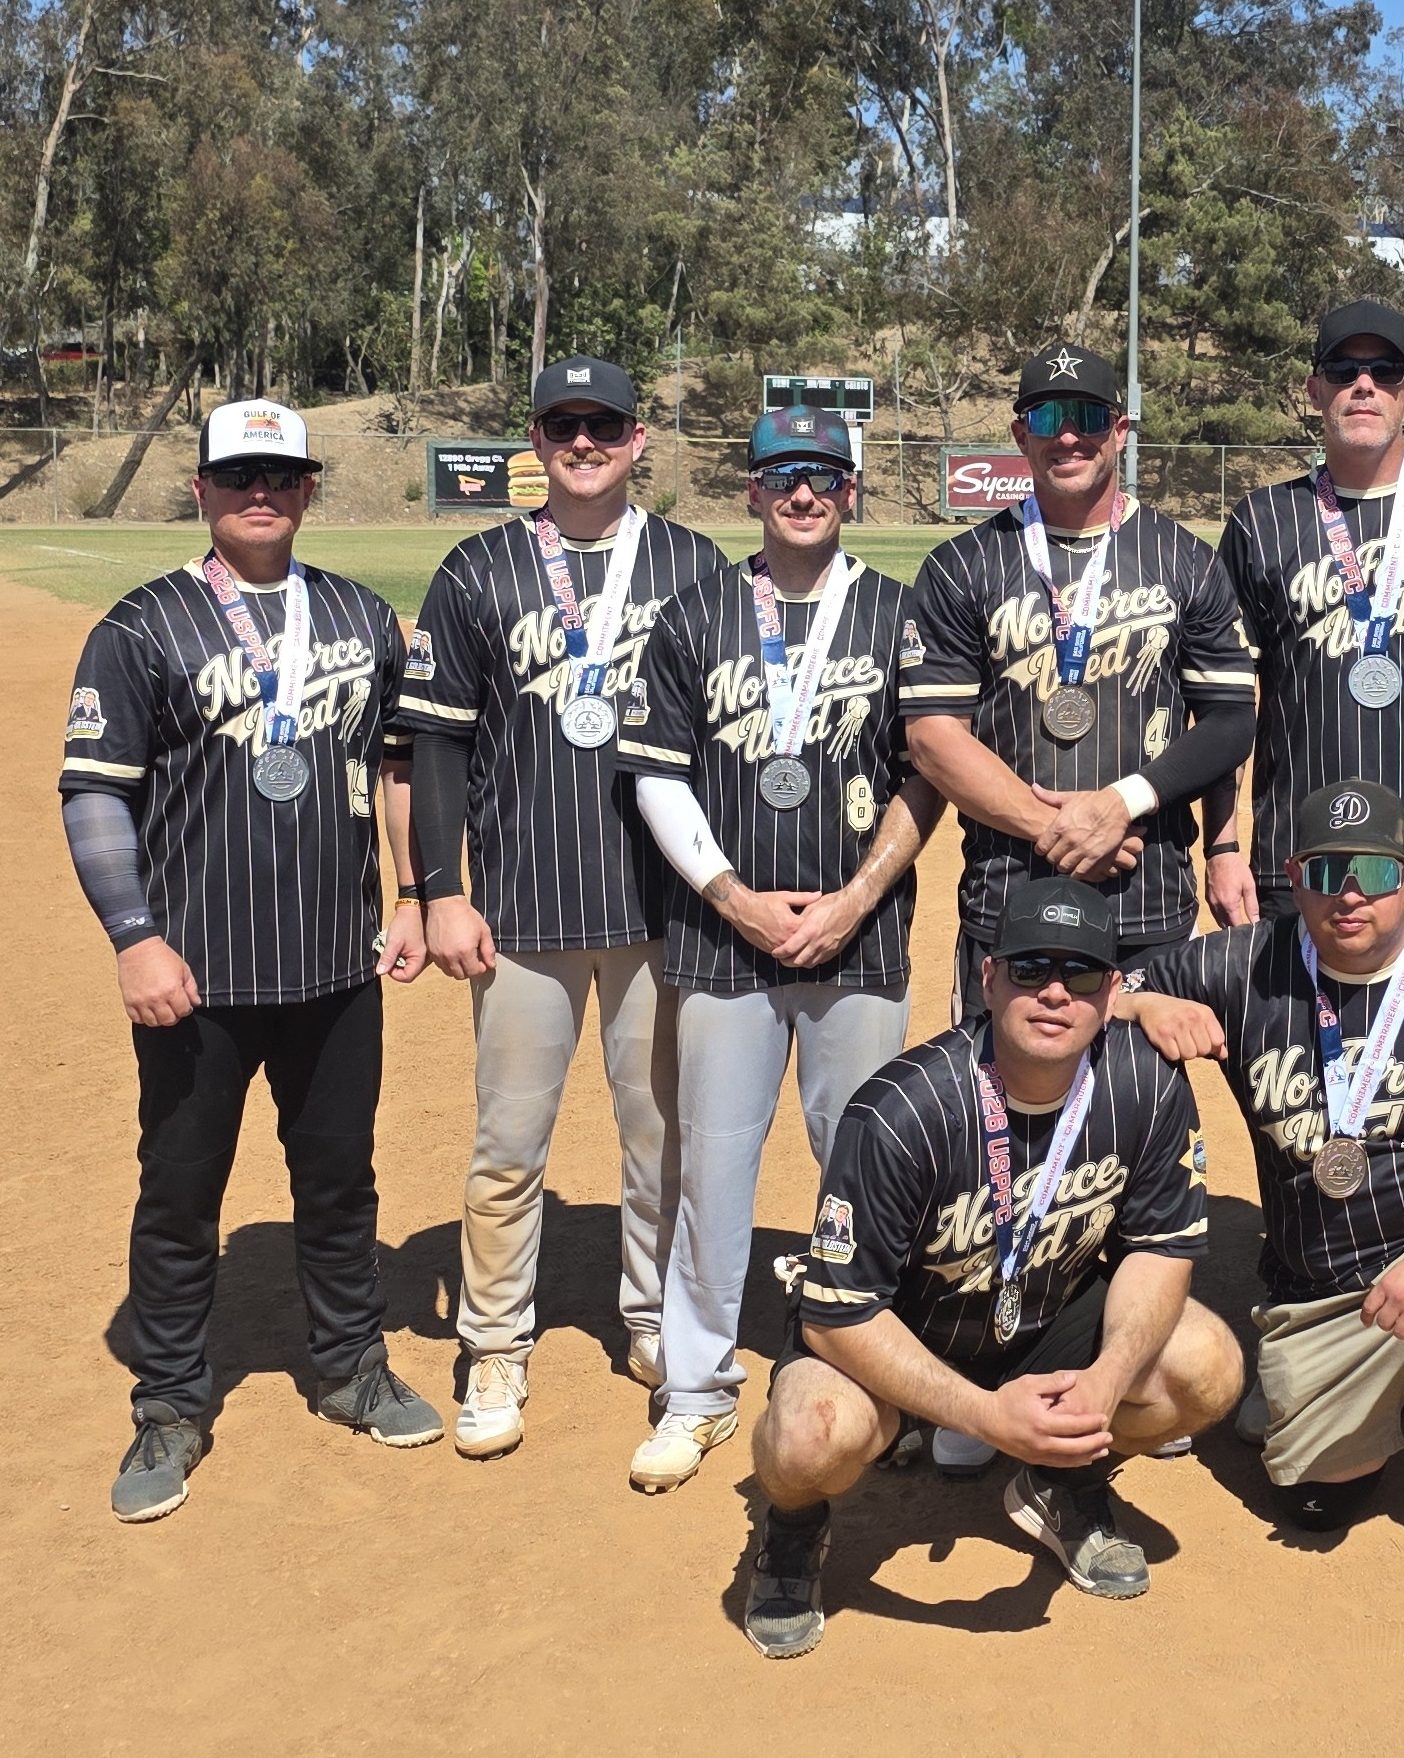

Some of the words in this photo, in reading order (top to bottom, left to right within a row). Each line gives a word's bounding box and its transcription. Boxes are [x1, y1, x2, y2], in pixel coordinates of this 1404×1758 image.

[242, 431, 285, 441] AMERICA
[472, 463, 496, 473] Away
[995, 492, 1025, 501] CASINO
[1288, 554, 1346, 624] No
[1326, 523, 1364, 595] USPFC
[203, 556, 241, 605] 2026
[225, 606, 273, 673] USPFC
[547, 560, 584, 631] USPFC
[988, 592, 1052, 661] No
[509, 604, 567, 677] No
[197, 646, 263, 722] No
[706, 654, 765, 724] No
[1144, 706, 1170, 761] 4
[846, 774, 876, 832] 8
[1250, 1044, 1320, 1114] No
[1347, 1066, 1375, 1125] COMMITMENT
[1372, 998, 1401, 1059] CAMARADERIE
[978, 1060, 1009, 1134] 2026
[986, 1136, 1014, 1227] USPFC
[1039, 1143, 1065, 1207] COMMITMENT
[925, 1186, 996, 1255] No
